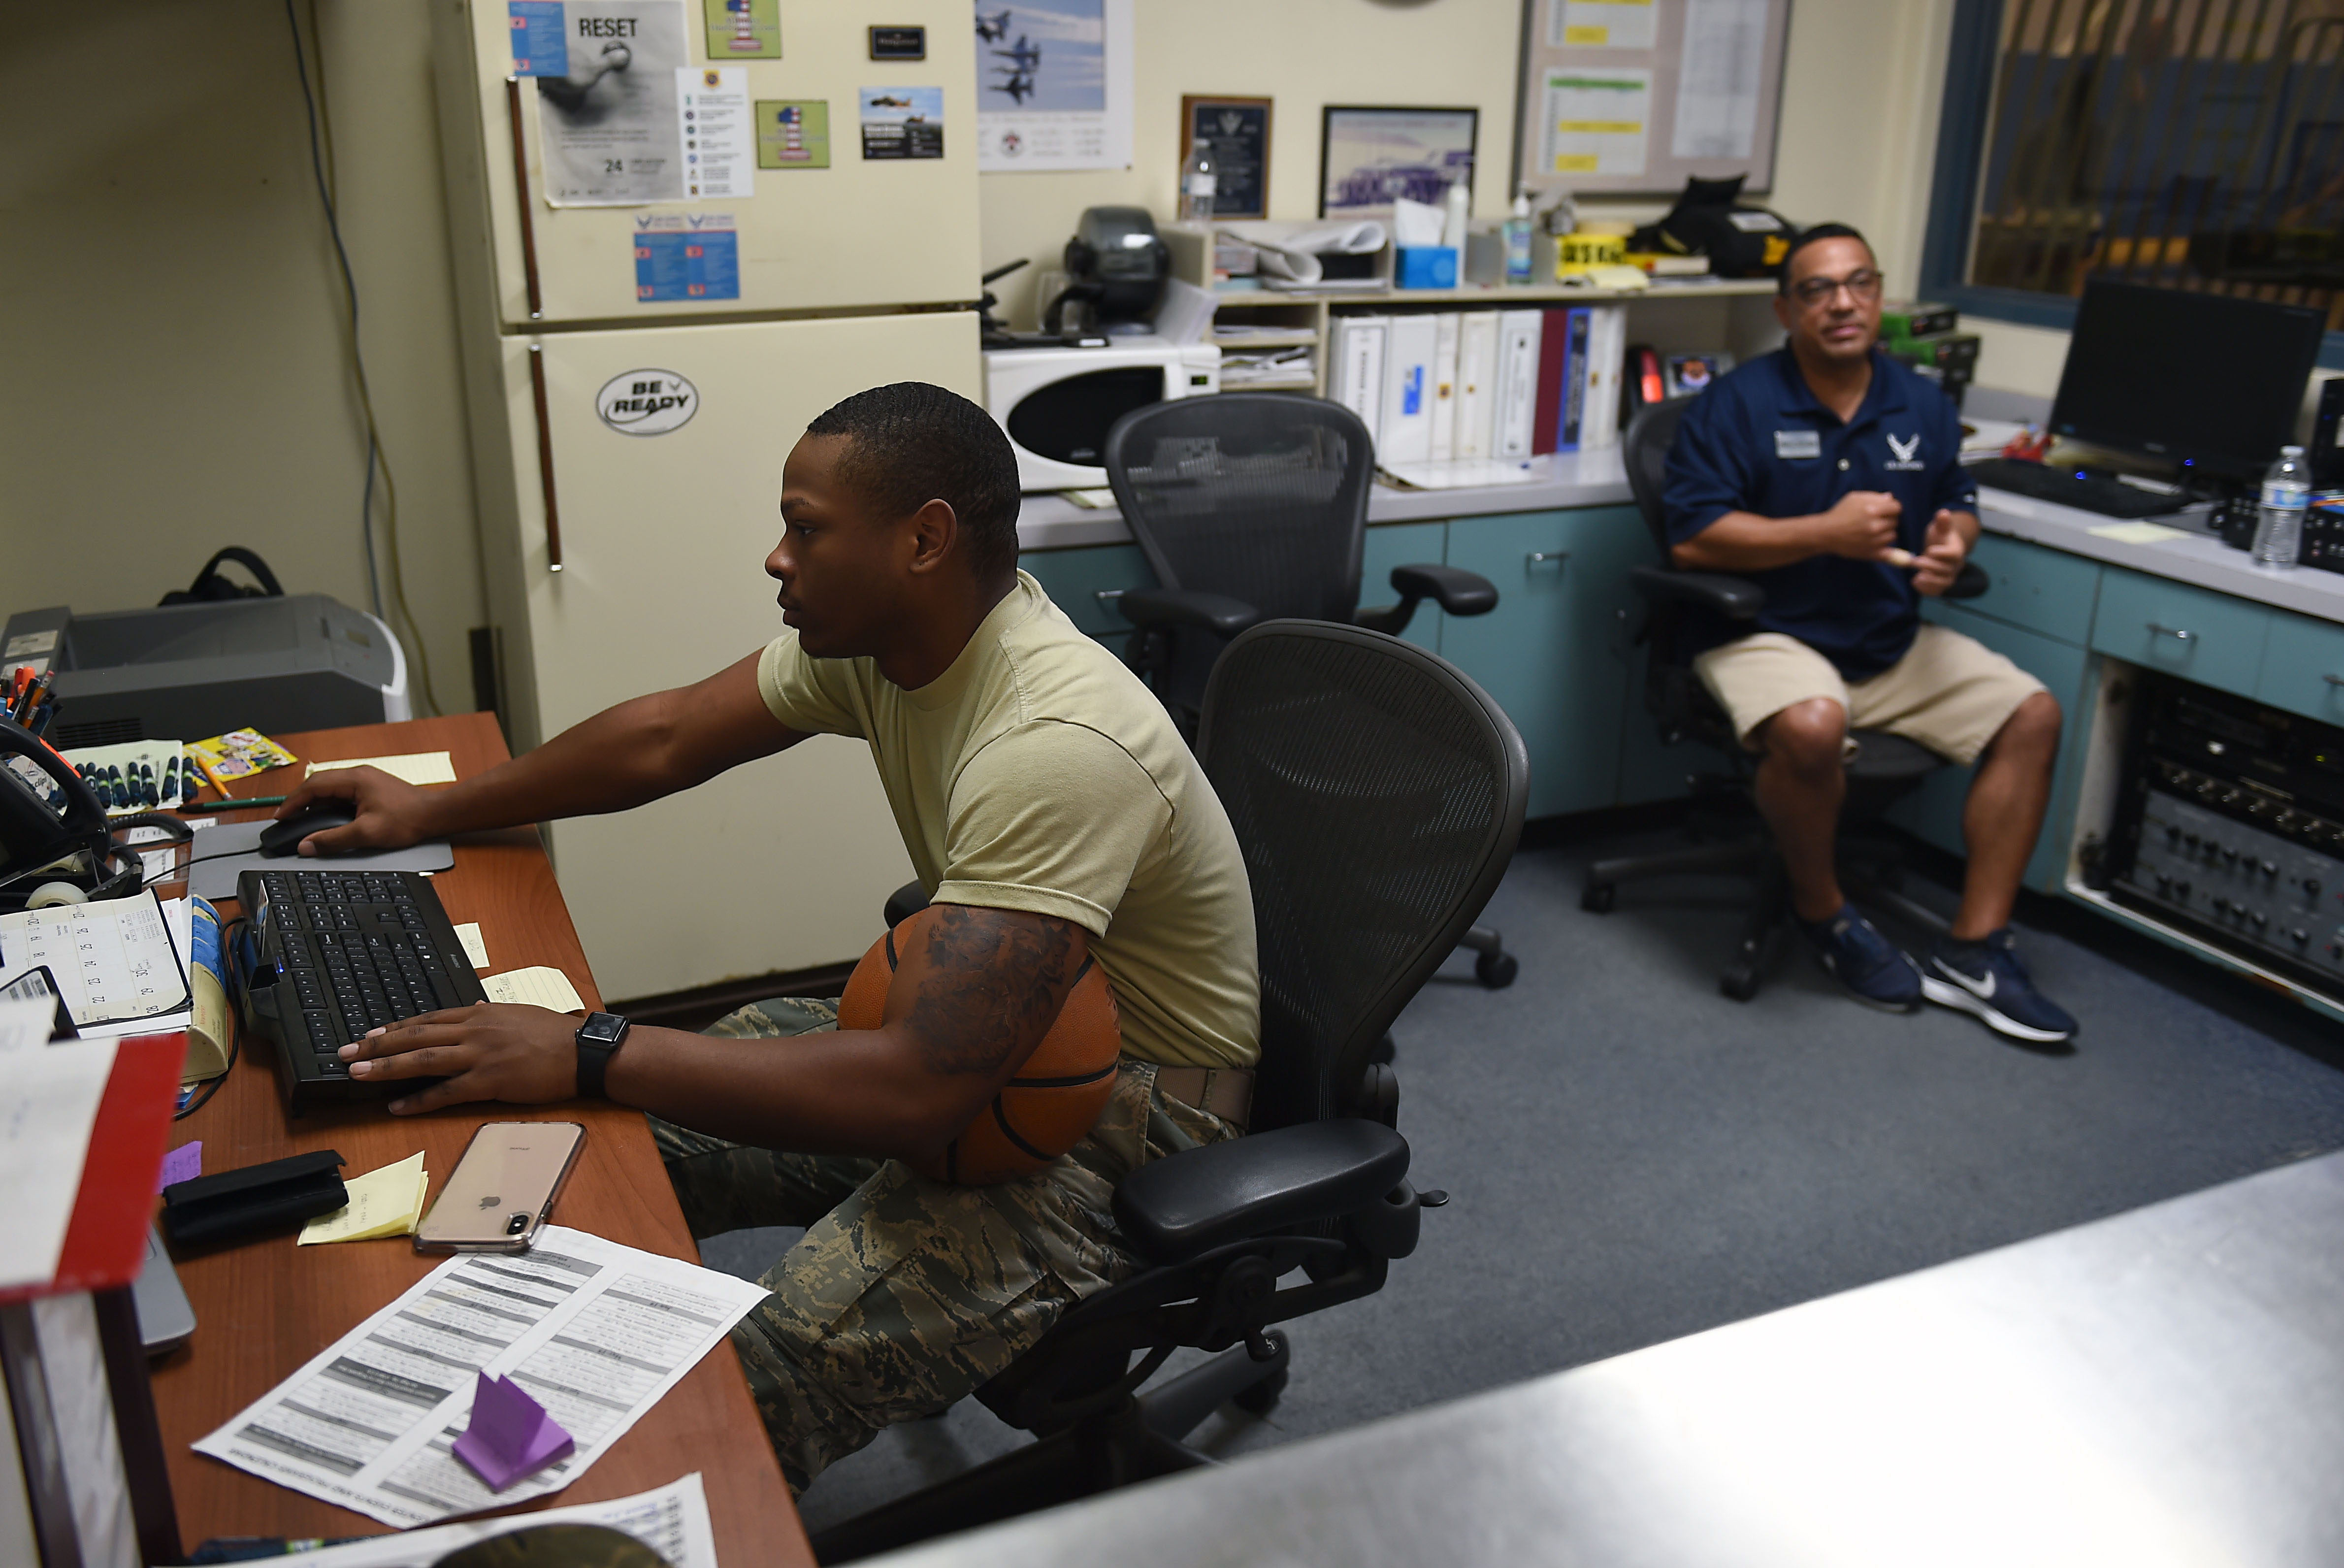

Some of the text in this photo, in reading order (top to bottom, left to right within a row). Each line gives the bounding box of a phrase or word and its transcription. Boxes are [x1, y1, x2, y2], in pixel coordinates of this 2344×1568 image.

[580, 18, 637, 36] RESET
[605, 159, 622, 172] 24
[633, 381, 662, 394] BE
[615, 395, 689, 415] READY
[35, 776, 47, 787] clips
[135, 969, 148, 978] 30
[92, 995, 105, 1004] 22
[146, 1005, 159, 1013] 28
